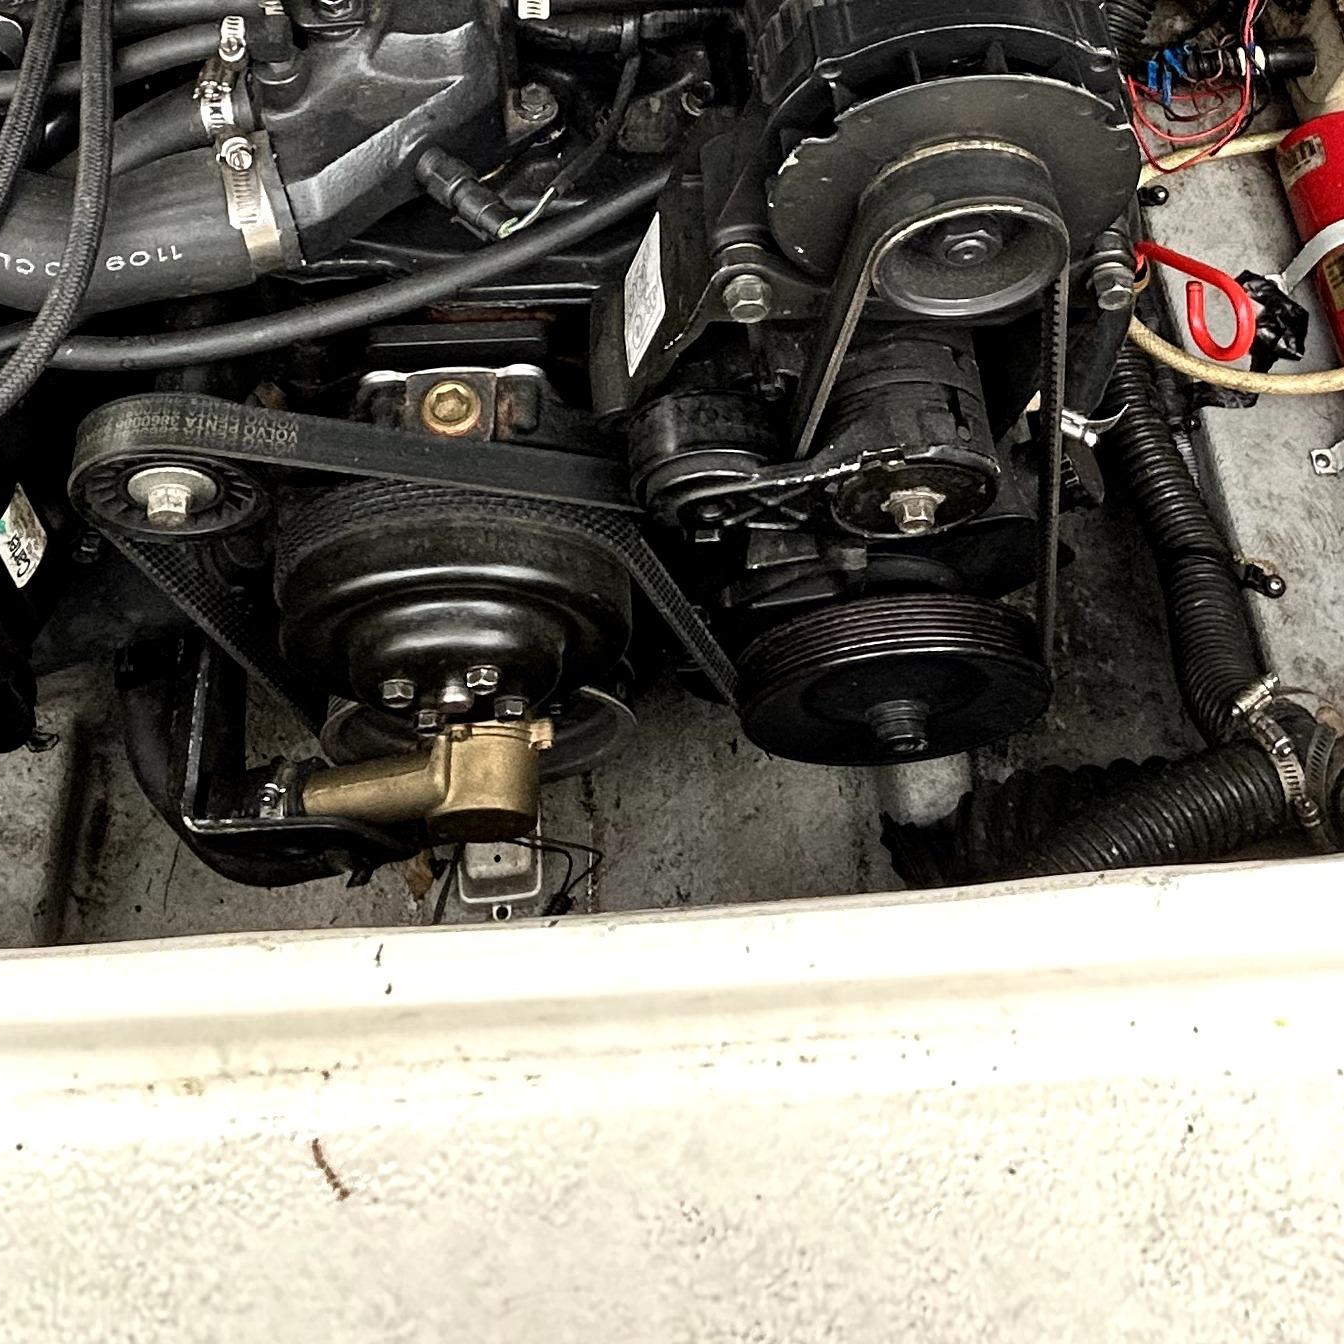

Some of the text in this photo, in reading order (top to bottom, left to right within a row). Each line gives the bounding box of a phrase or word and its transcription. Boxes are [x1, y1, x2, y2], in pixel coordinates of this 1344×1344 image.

[104, 244, 183, 272] 1109
[185, 415, 241, 434] PENTA
[244, 423, 298, 444] VOLVO
[7, 533, 31, 578] Carter
